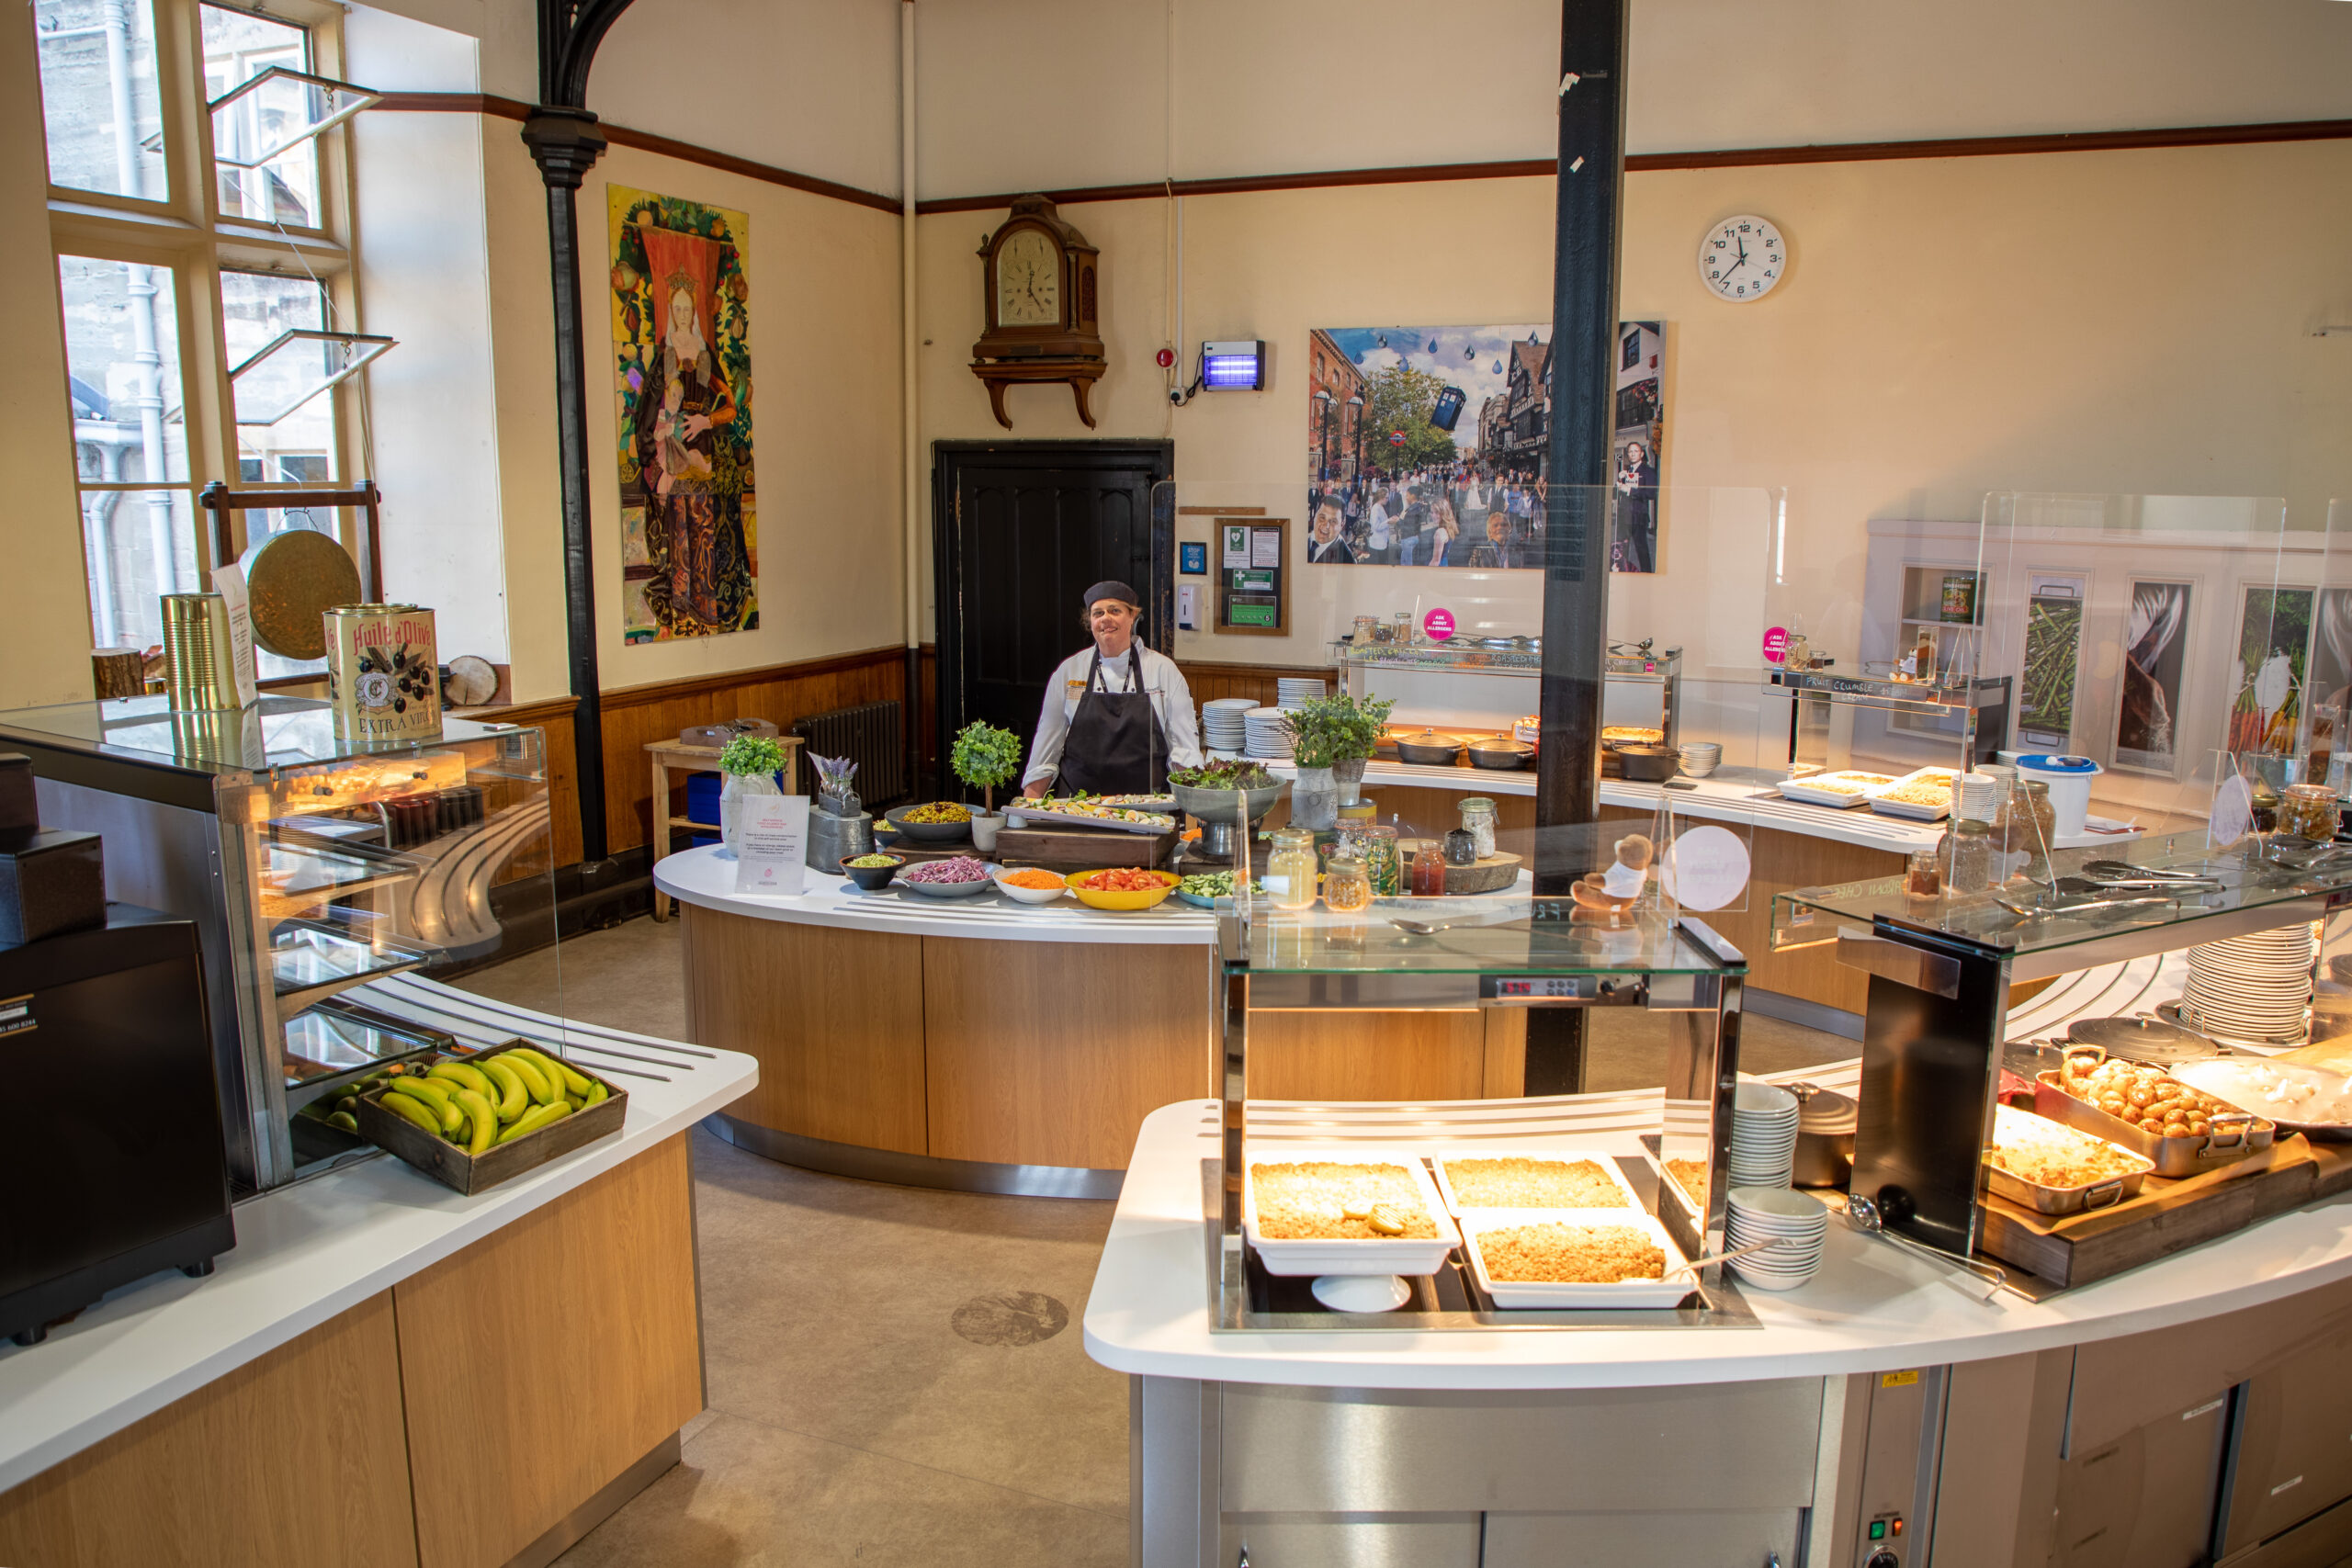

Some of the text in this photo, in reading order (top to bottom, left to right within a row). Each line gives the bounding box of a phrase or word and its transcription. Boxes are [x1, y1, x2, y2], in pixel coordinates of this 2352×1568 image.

[1738, 224, 1750, 232] 12
[1724, 230, 1735, 238] 11
[1713, 241, 1726, 249] 10
[1770, 254, 1777, 263] 3
[1737, 286, 1745, 294] 6
[353, 620, 431, 656] Huile d'Olive
[1806, 676, 1828, 687] FRUIT
[1833, 681, 1873, 693] CRUMBLE
[358, 712, 434, 733] EXTRA VIRG
[7, 1022, 19, 1031] 600
[20, 1019, 36, 1027] 8244
